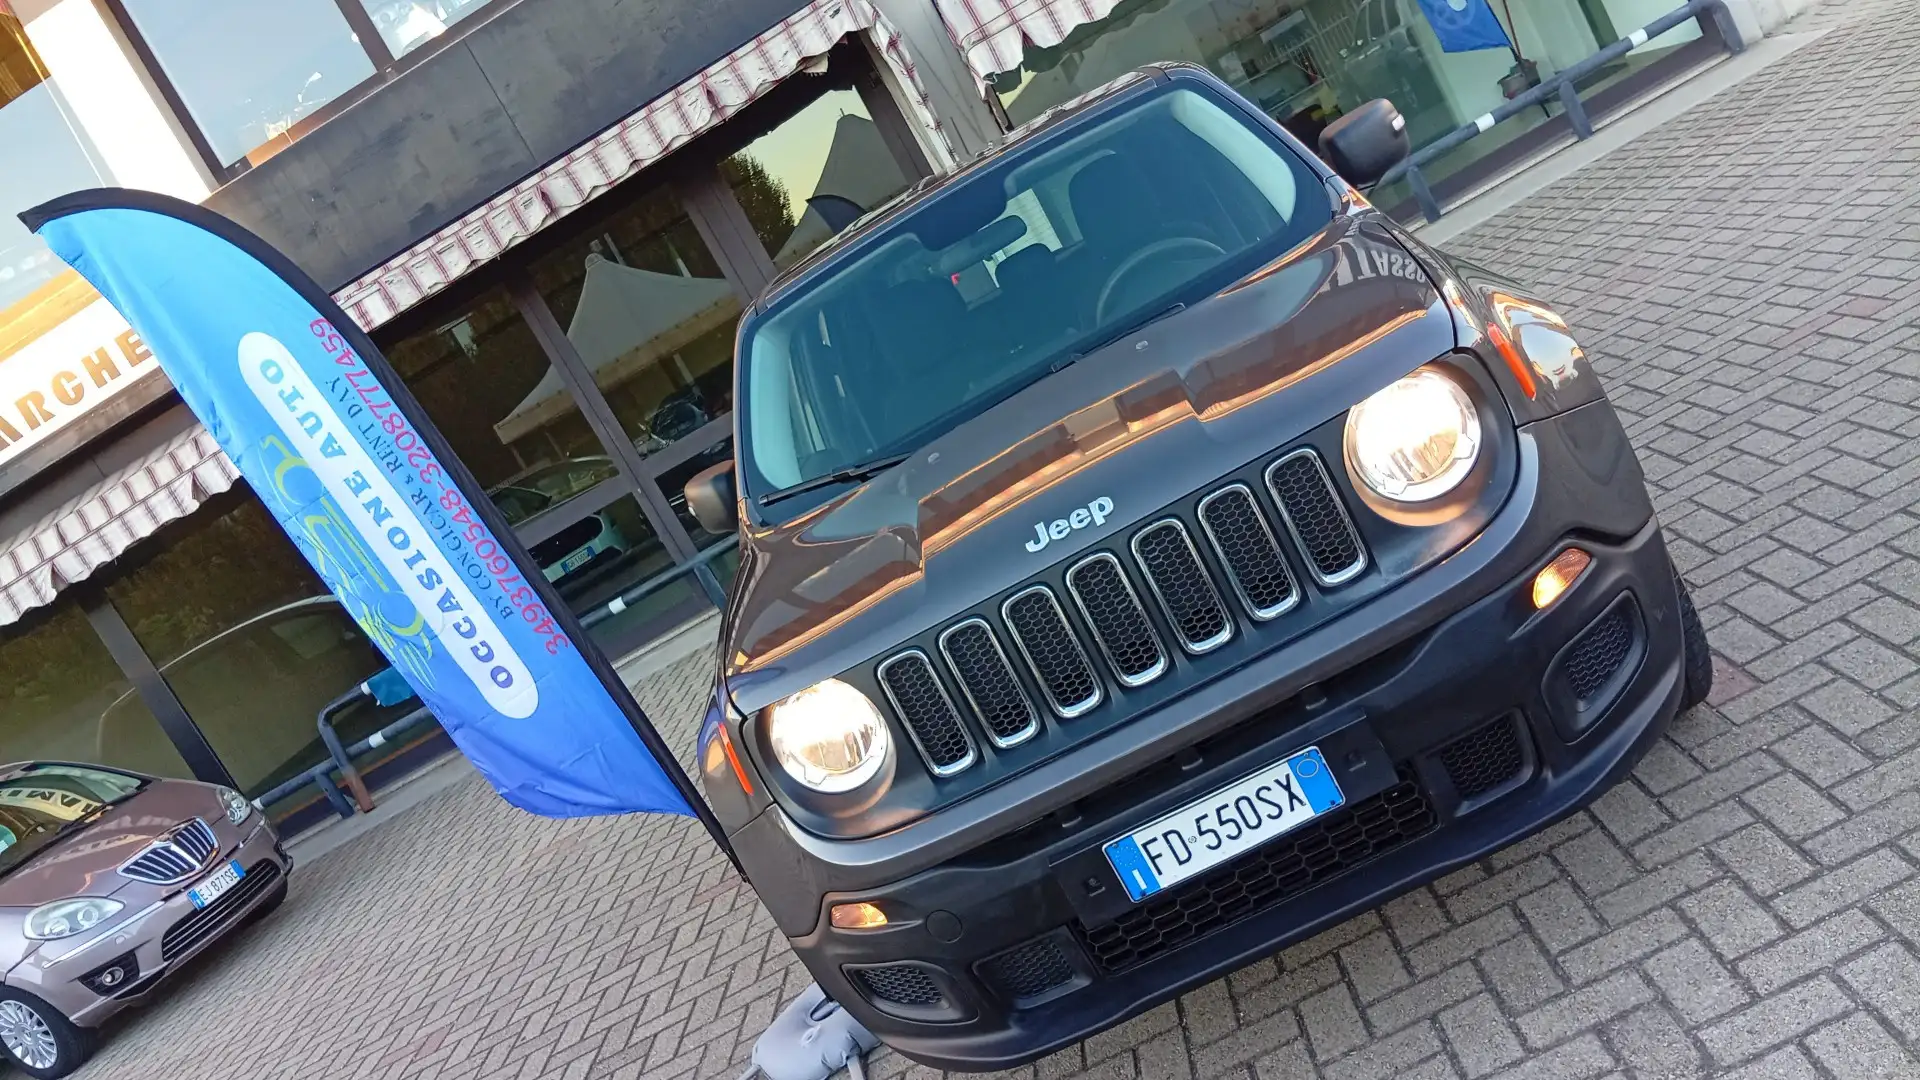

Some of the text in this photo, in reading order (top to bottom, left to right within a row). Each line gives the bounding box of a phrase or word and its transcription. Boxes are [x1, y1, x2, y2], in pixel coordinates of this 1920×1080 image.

[325, 376, 363, 419] DAY
[358, 423, 404, 474] RENT
[309, 317, 569, 656] 3493760548-3208777459
[404, 473, 414, 485] &
[259, 358, 514, 688] OCCASIONE AUTO
[1025, 496, 1114, 553] Jeep
[489, 591, 515, 620] BY
